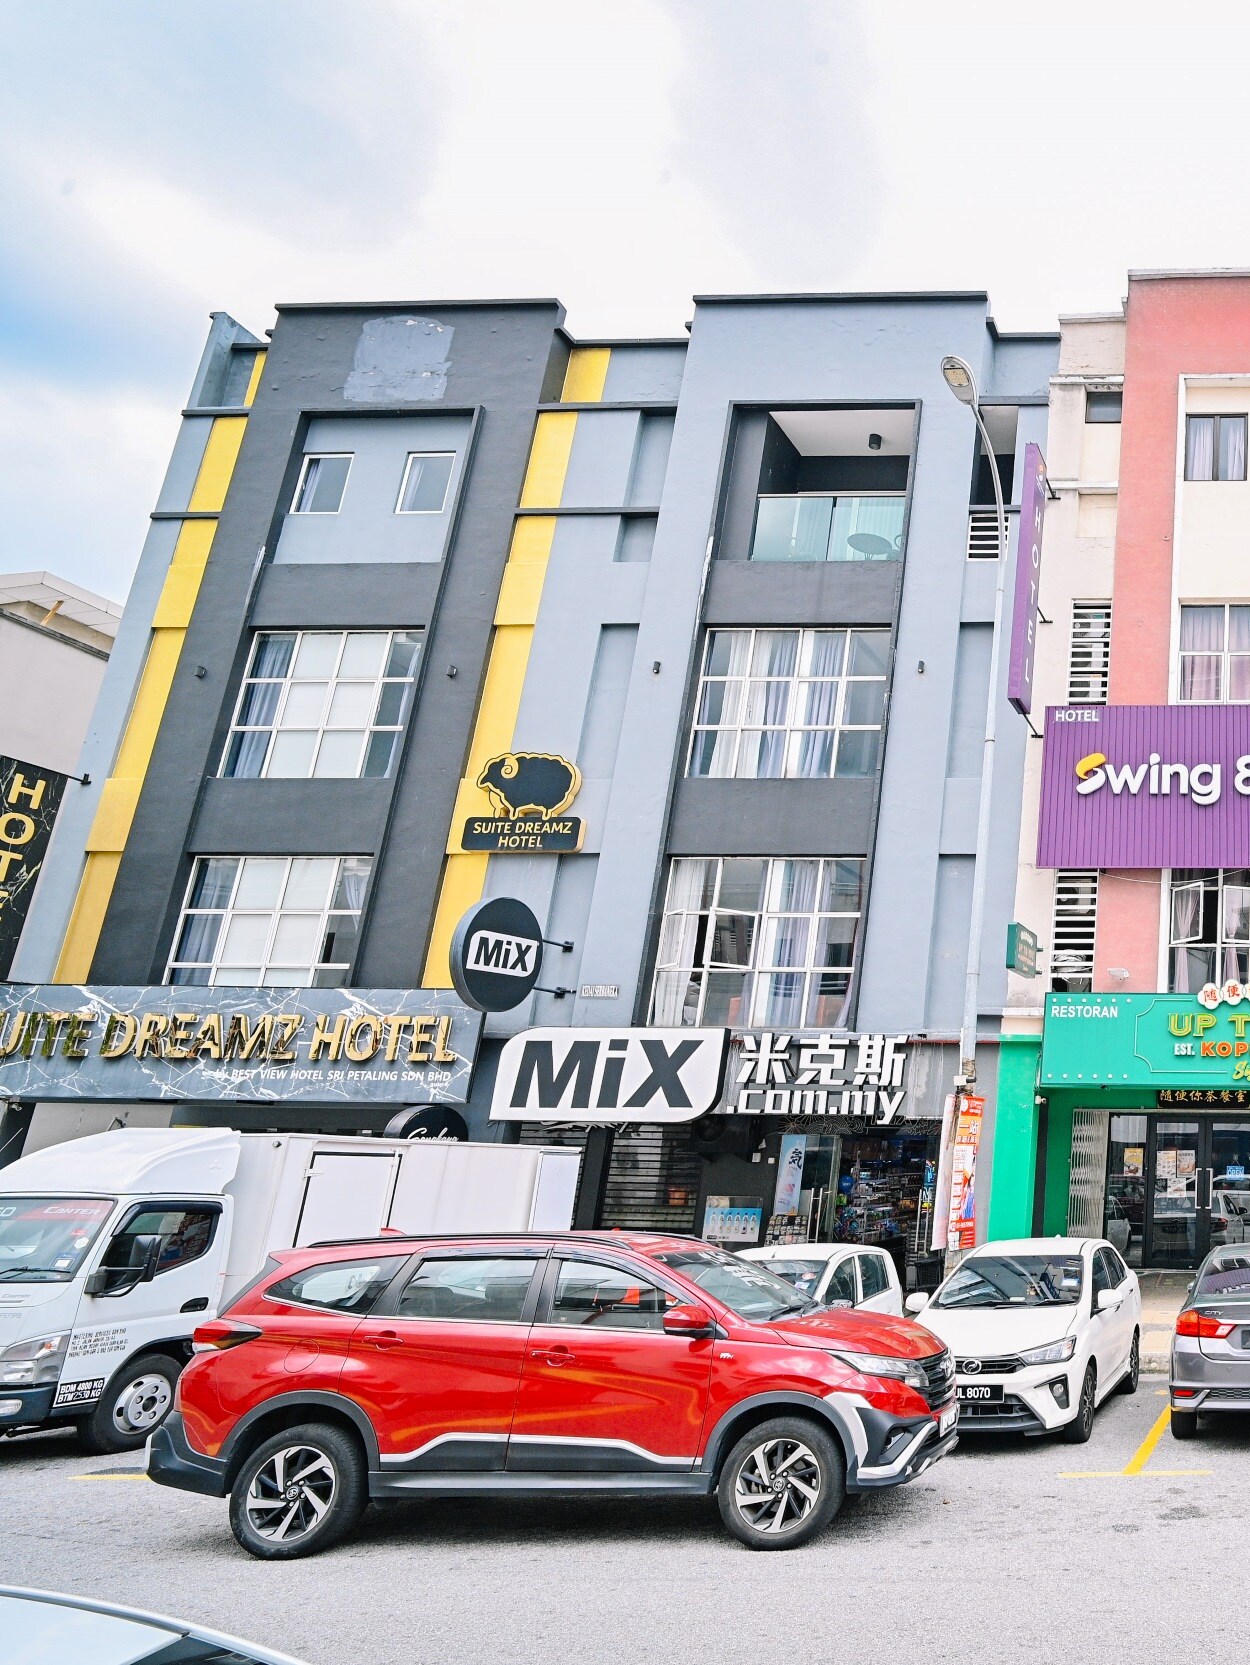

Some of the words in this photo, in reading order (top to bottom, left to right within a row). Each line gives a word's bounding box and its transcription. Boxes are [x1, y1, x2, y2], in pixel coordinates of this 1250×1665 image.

[1025, 506, 1041, 684] HOTEL
[1055, 709, 1099, 722] HOTEL
[473, 822, 513, 834] SUITE
[515, 822, 572, 834] DREAMZ
[498, 836, 543, 848] HOTEL
[474, 936, 533, 972] MiX
[1051, 1005, 1118, 1018] RESTORAN
[1168, 1013, 1217, 1037] UP
[101, 1011, 305, 1061] DREAMZ
[309, 1014, 459, 1063] HOTEL
[1174, 1043, 1195, 1056] EST.
[737, 1033, 909, 1086] 米克斯
[231, 1071, 256, 1081] BEST
[260, 1071, 287, 1081] VIEW
[290, 1071, 324, 1081] HOTEL
[327, 1071, 344, 1082] SRI
[347, 1071, 397, 1082] PETALING
[401, 1071, 424, 1081] SDN
[428, 1071, 451, 1081] BHD
[510, 1039, 704, 1109] MiX
[726, 1089, 906, 1124] .com.my
[43, 1206, 100, 1215] CANTER
[60, 1384, 76, 1393] BDM
[93, 1380, 103, 1388] KG
[966, 1387, 990, 1399] 8070
[58, 1393, 74, 1403] BTM
[90, 1389, 101, 1397] KG
